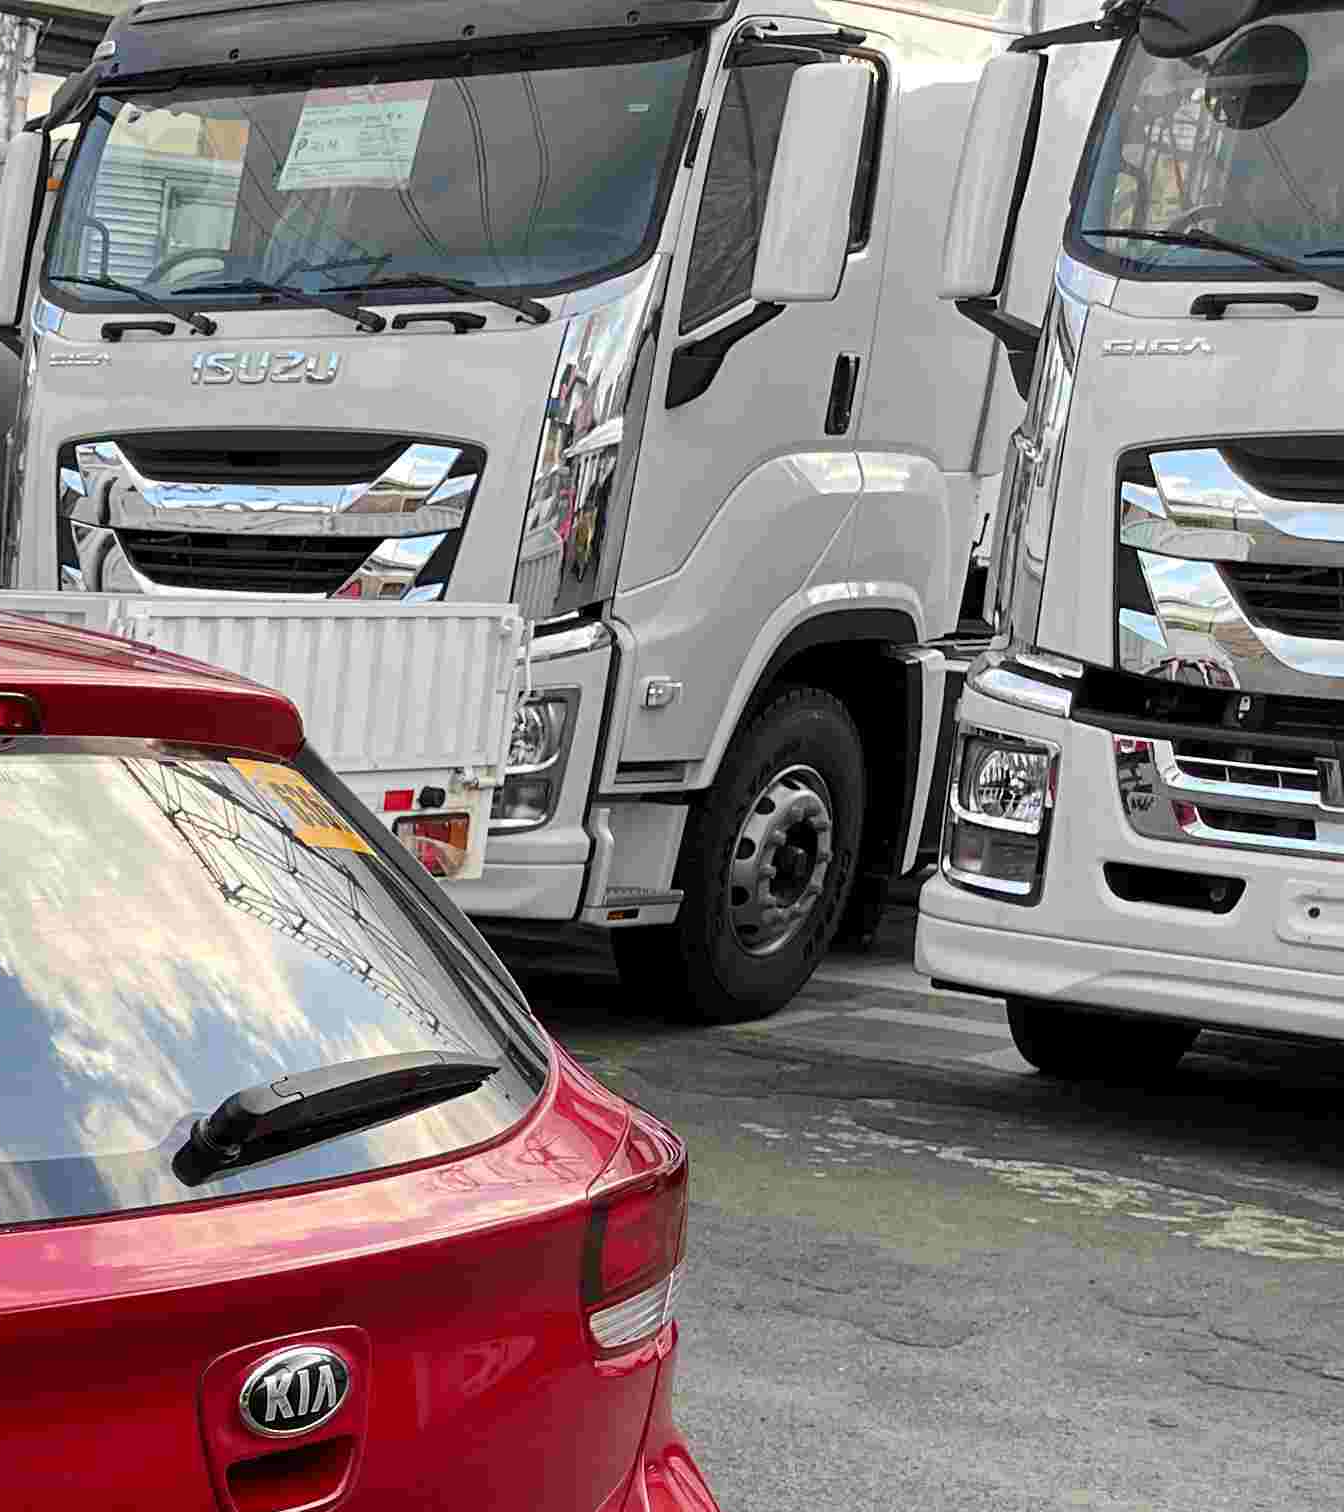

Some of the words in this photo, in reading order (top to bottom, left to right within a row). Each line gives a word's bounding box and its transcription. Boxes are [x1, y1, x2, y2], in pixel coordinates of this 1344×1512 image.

[1101, 338, 1212, 358] GIGA
[191, 351, 337, 385] ISUZU
[263, 1364, 337, 1422] KIA
